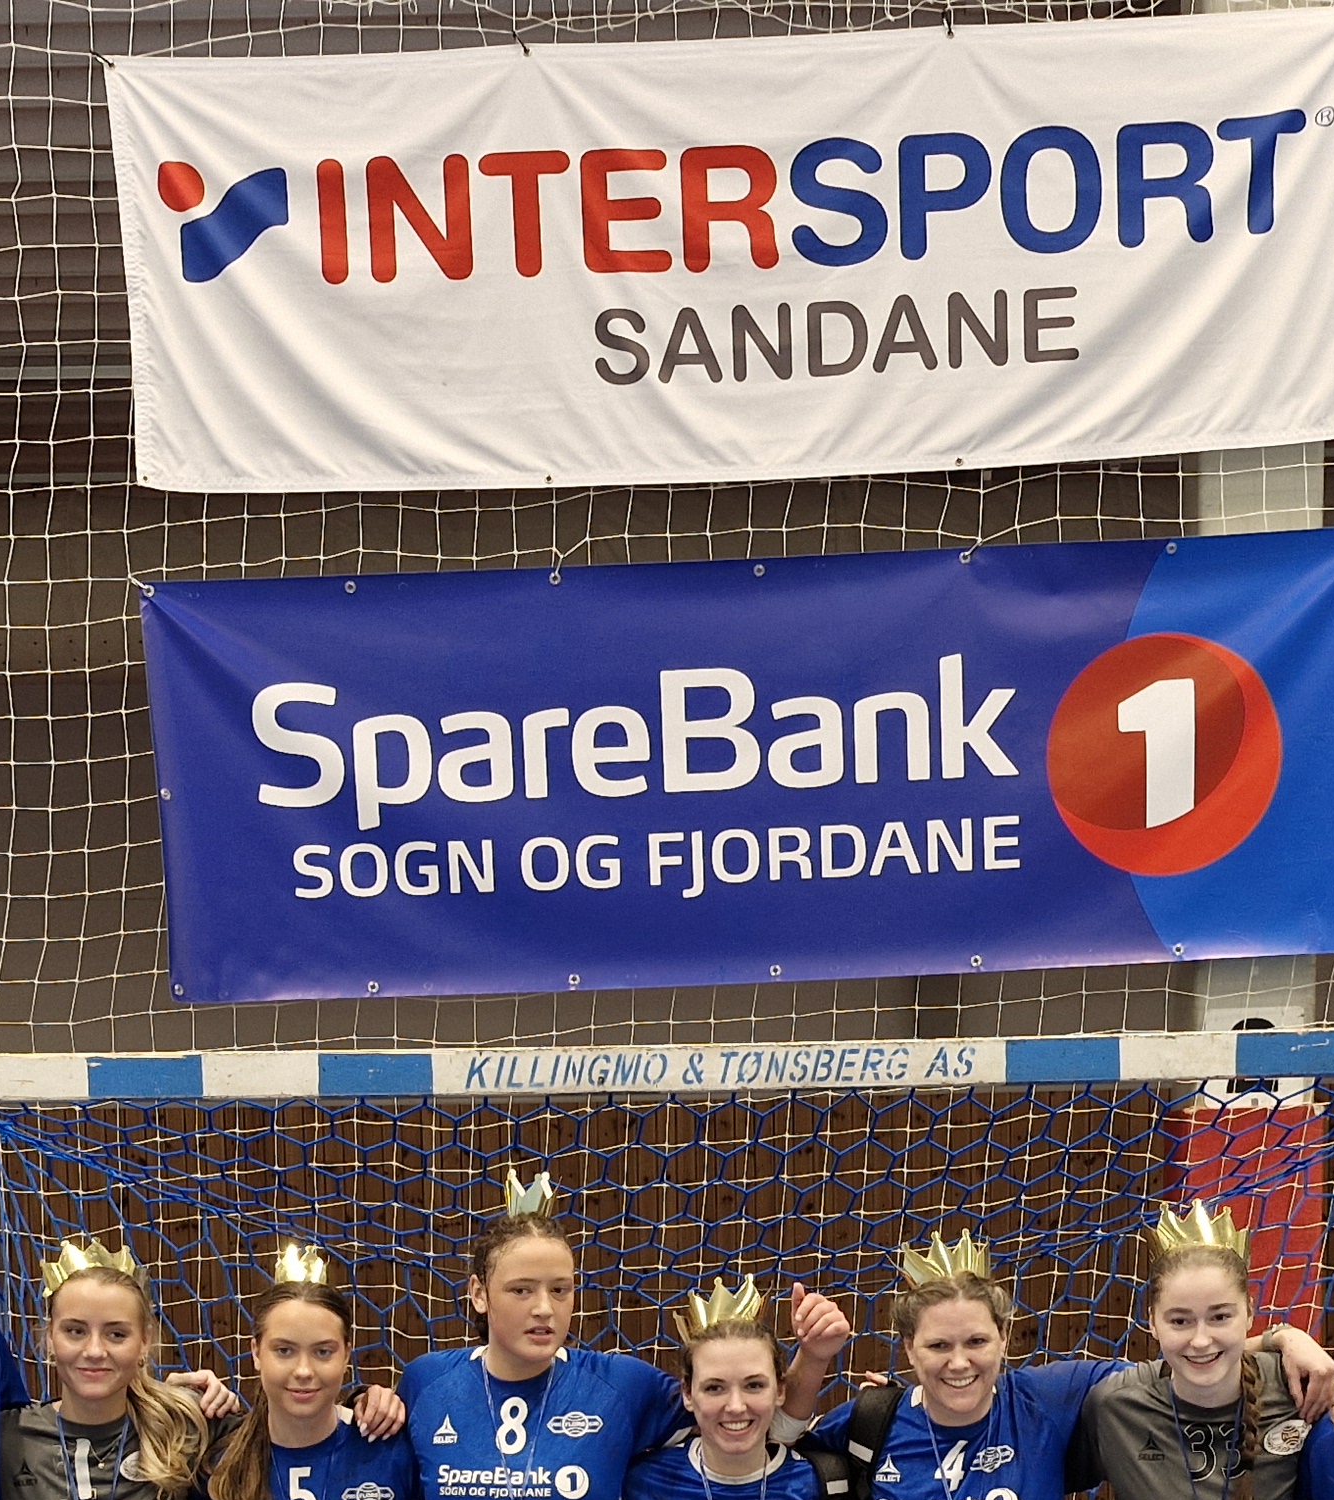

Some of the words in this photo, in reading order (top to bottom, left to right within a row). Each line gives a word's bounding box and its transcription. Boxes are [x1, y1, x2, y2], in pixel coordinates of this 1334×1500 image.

[316, 108, 1306, 283] INTERSPORT
[593, 285, 1080, 386] SANDANE
[251, 653, 1020, 831] SpareBank
[1117, 677, 1197, 829] 1
[292, 838, 495, 900] SOGN
[521, 834, 622, 891] OG
[648, 815, 1022, 900] FJORDANE
[465, 1053, 668, 1090] KILLINGMO
[681, 1052, 704, 1083] &
[717, 1047, 911, 1085] TØNSBERG
[923, 1045, 977, 1080] AS
[433, 1435, 457, 1444] SELECT
[495, 1396, 528, 1455] 8
[437, 1465, 551, 1487] SpareBank
[875, 1474, 900, 1482] SELECT
[934, 1440, 968, 1492] 4
[1138, 1453, 1164, 1461] SELECT
[1183, 1422, 1246, 1482] 33
[439, 1486, 466, 1496] SOGN
[469, 1486, 486, 1496] OG
